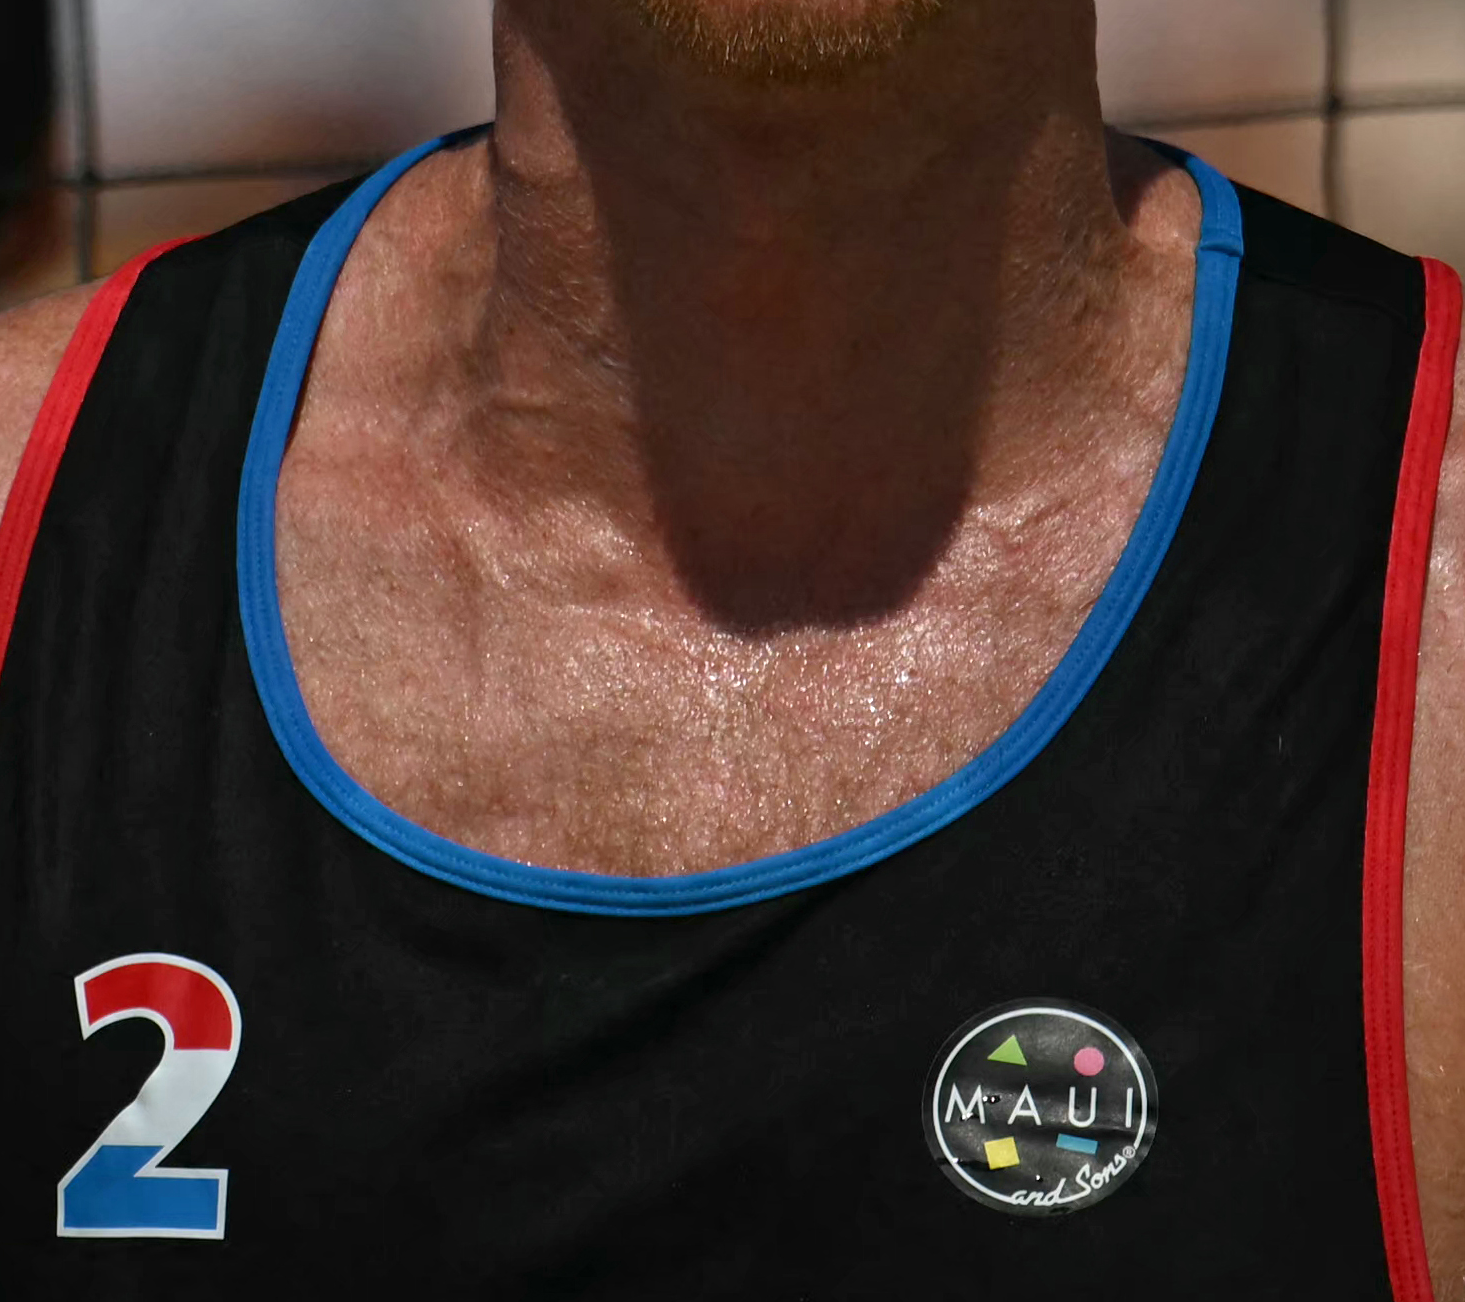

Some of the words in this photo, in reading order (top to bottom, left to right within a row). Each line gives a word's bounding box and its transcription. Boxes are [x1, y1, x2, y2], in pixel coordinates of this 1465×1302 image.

[56, 951, 243, 1241] 2
[944, 1083, 1134, 1129] MAUI
[1009, 1177, 1067, 1207] and
